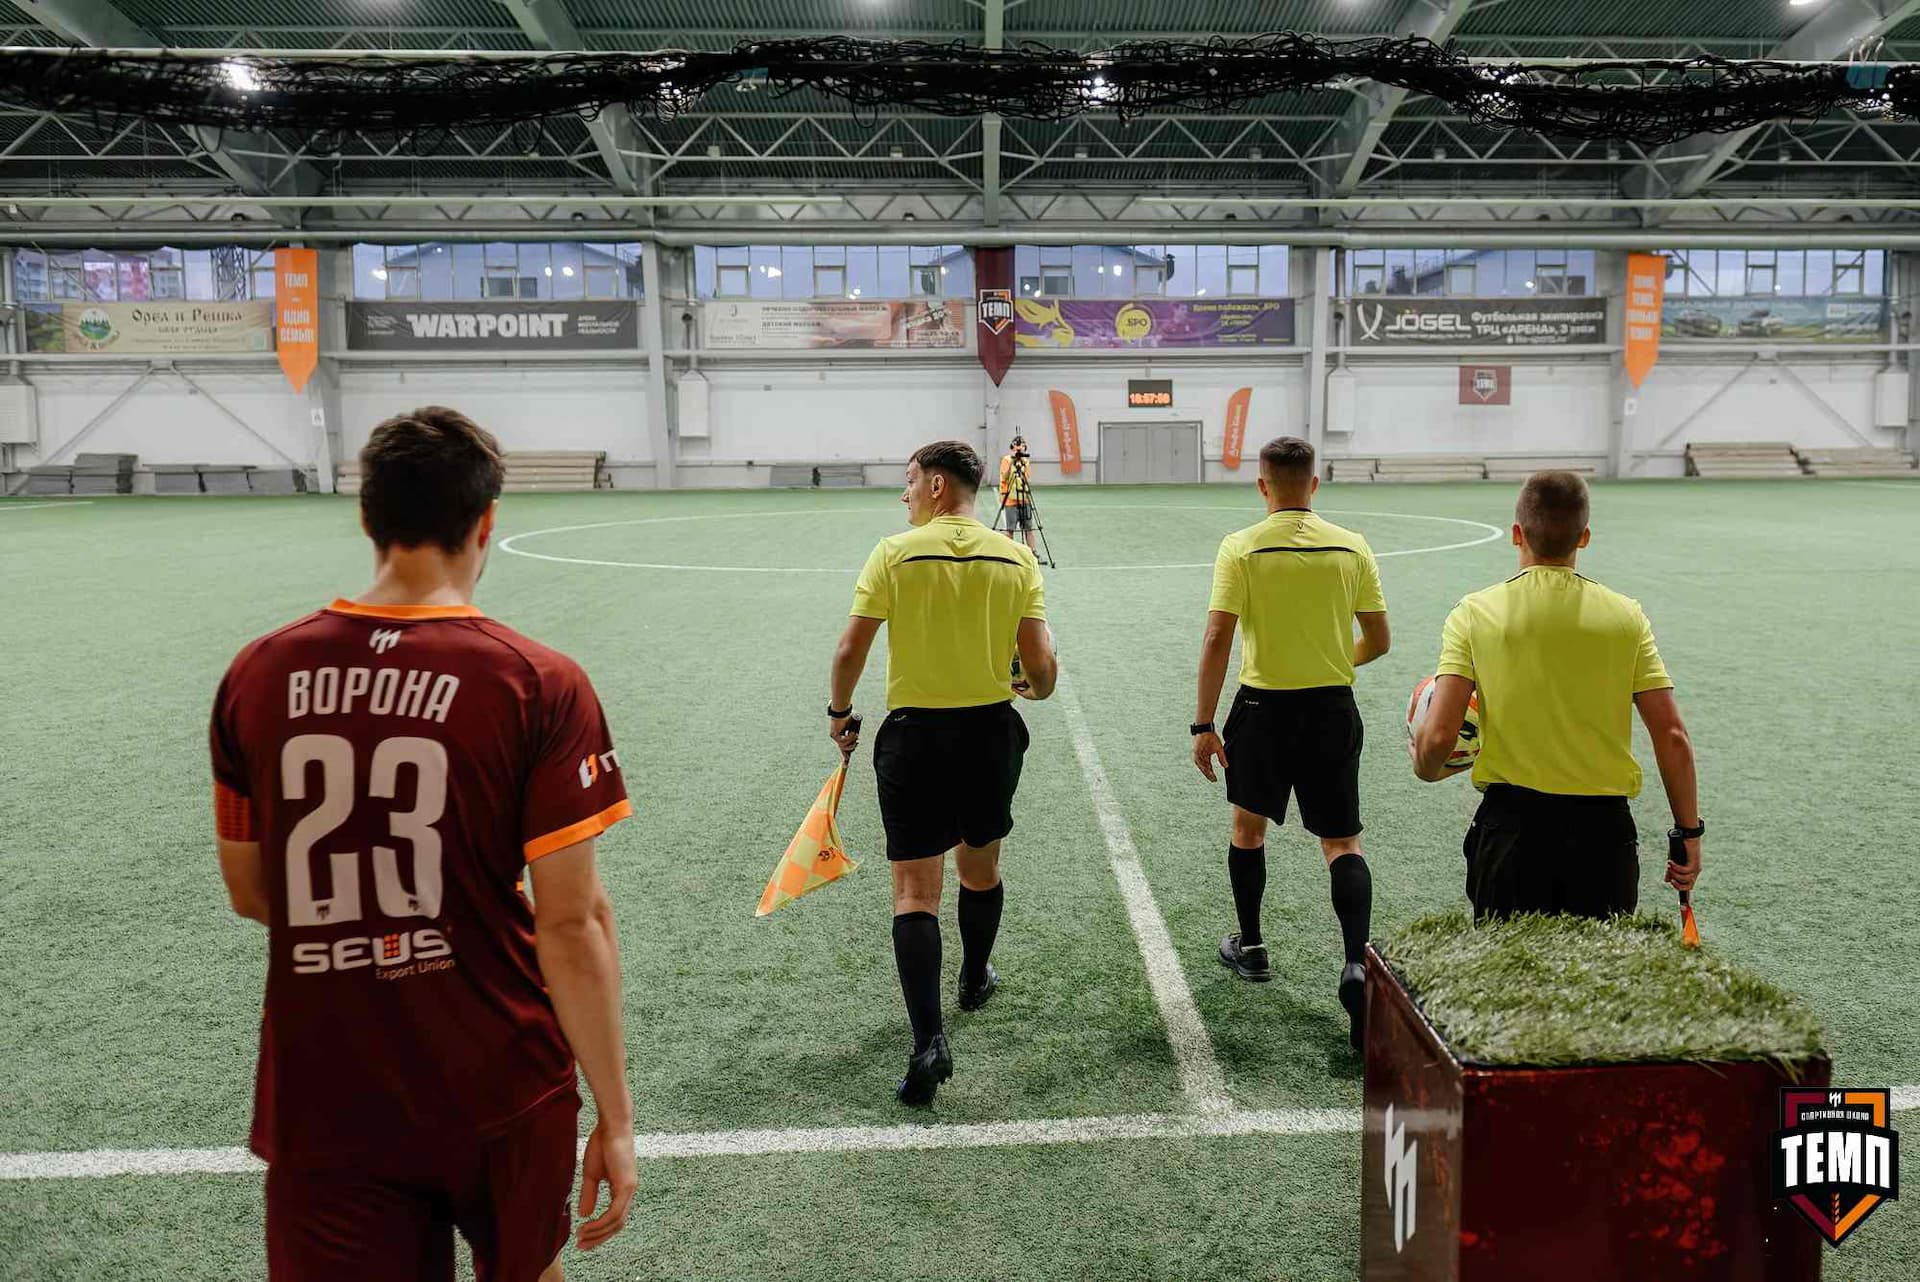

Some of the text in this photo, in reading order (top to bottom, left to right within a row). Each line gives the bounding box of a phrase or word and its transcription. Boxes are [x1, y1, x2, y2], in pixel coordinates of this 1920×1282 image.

[193, 308, 242, 322] Решка
[982, 301, 1010, 318] ТЕМП
[1384, 309, 1472, 331] JÖGEL
[1471, 312, 1538, 323] Футбольная
[406, 313, 568, 338] WARPOINT
[1476, 324, 1500, 336] ТРЦ
[1560, 324, 1568, 334] 3
[287, 666, 460, 724] ВОРОНА
[280, 734, 449, 927] 23
[292, 928, 453, 974] SEUS
[375, 957, 456, 981] Export Union
